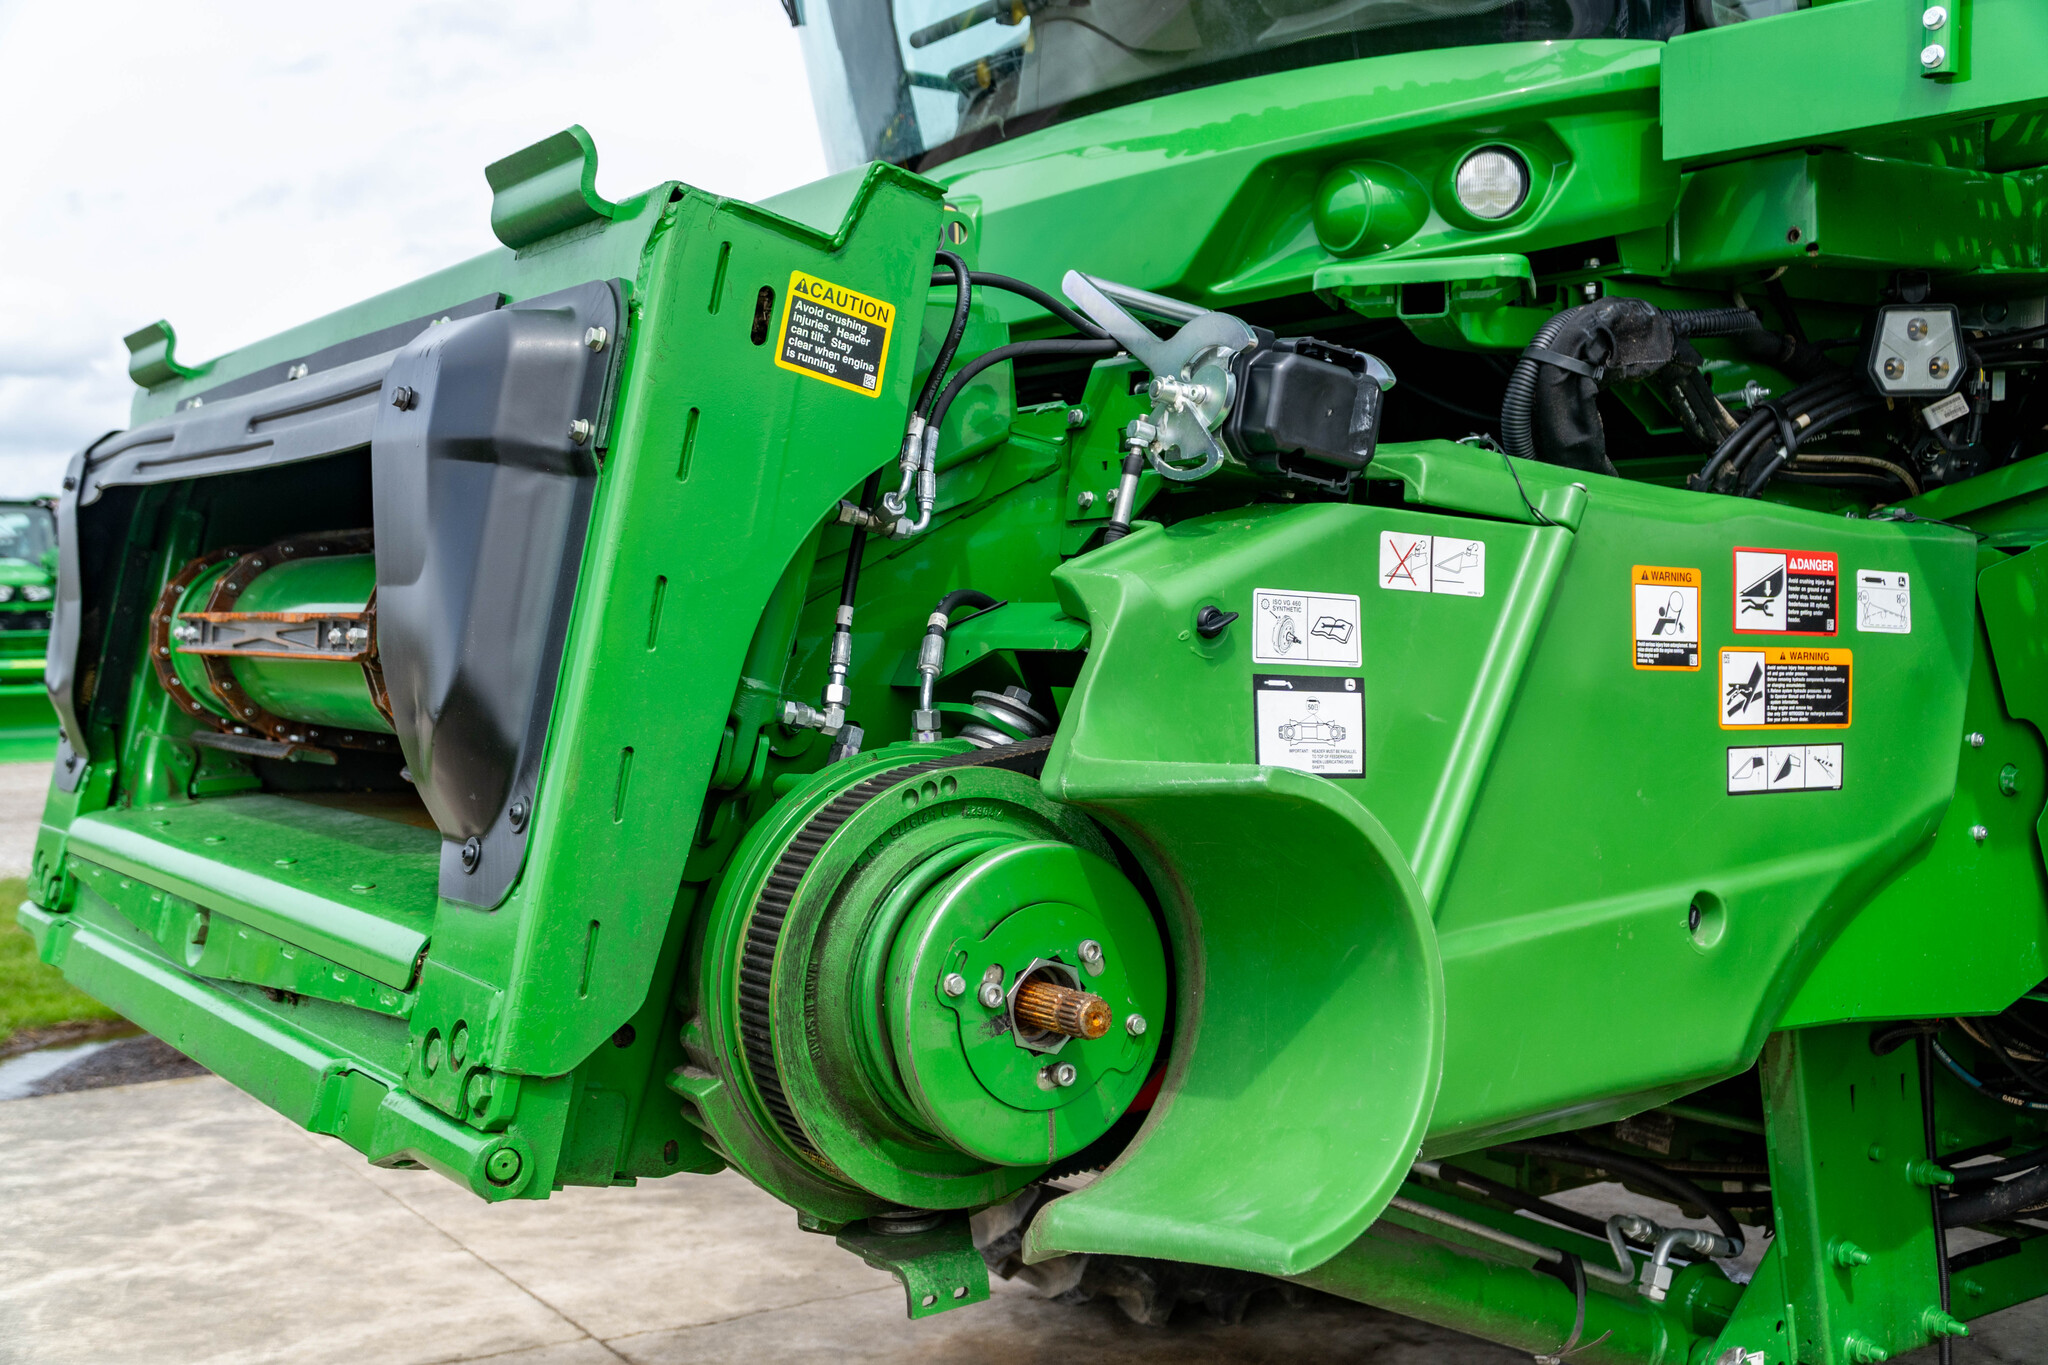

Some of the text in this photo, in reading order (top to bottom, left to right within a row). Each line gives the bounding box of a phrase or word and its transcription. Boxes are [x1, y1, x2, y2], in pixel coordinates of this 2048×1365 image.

[795, 300, 868, 335] Avoid crushing
[810, 282, 889, 323] CAUTION
[790, 325, 853, 354] can tilt. Stay
[793, 312, 871, 346] injuries. Header
[786, 347, 838, 374] is running.
[788, 336, 875, 372] clear when engine
[1651, 571, 1692, 582] WARNING
[1797, 558, 1834, 571] DANGER
[1790, 652, 1830, 661] WARNING
[804, 961, 822, 1062] MADE IN SPAIN
